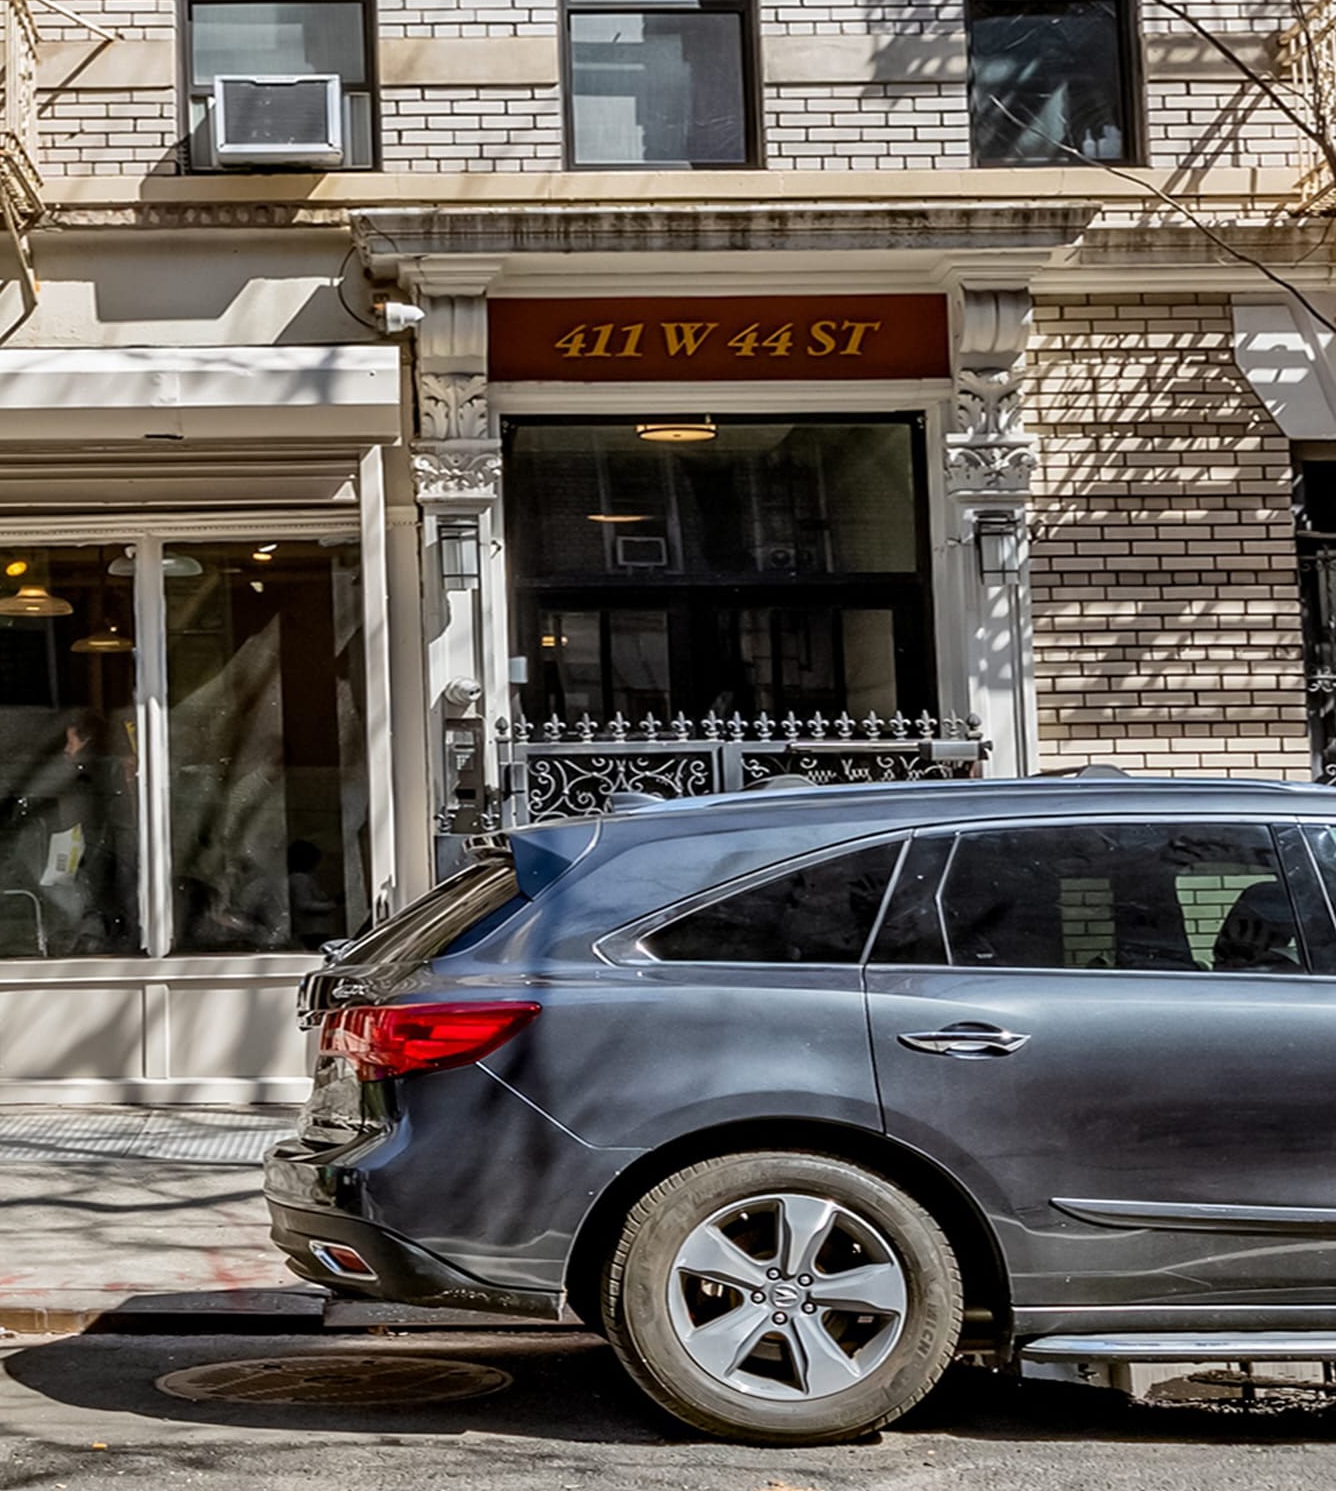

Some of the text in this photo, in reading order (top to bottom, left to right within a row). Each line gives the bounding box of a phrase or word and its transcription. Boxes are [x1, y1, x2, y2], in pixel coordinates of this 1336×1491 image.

[554, 320, 881, 357] 411 W 44 ST
